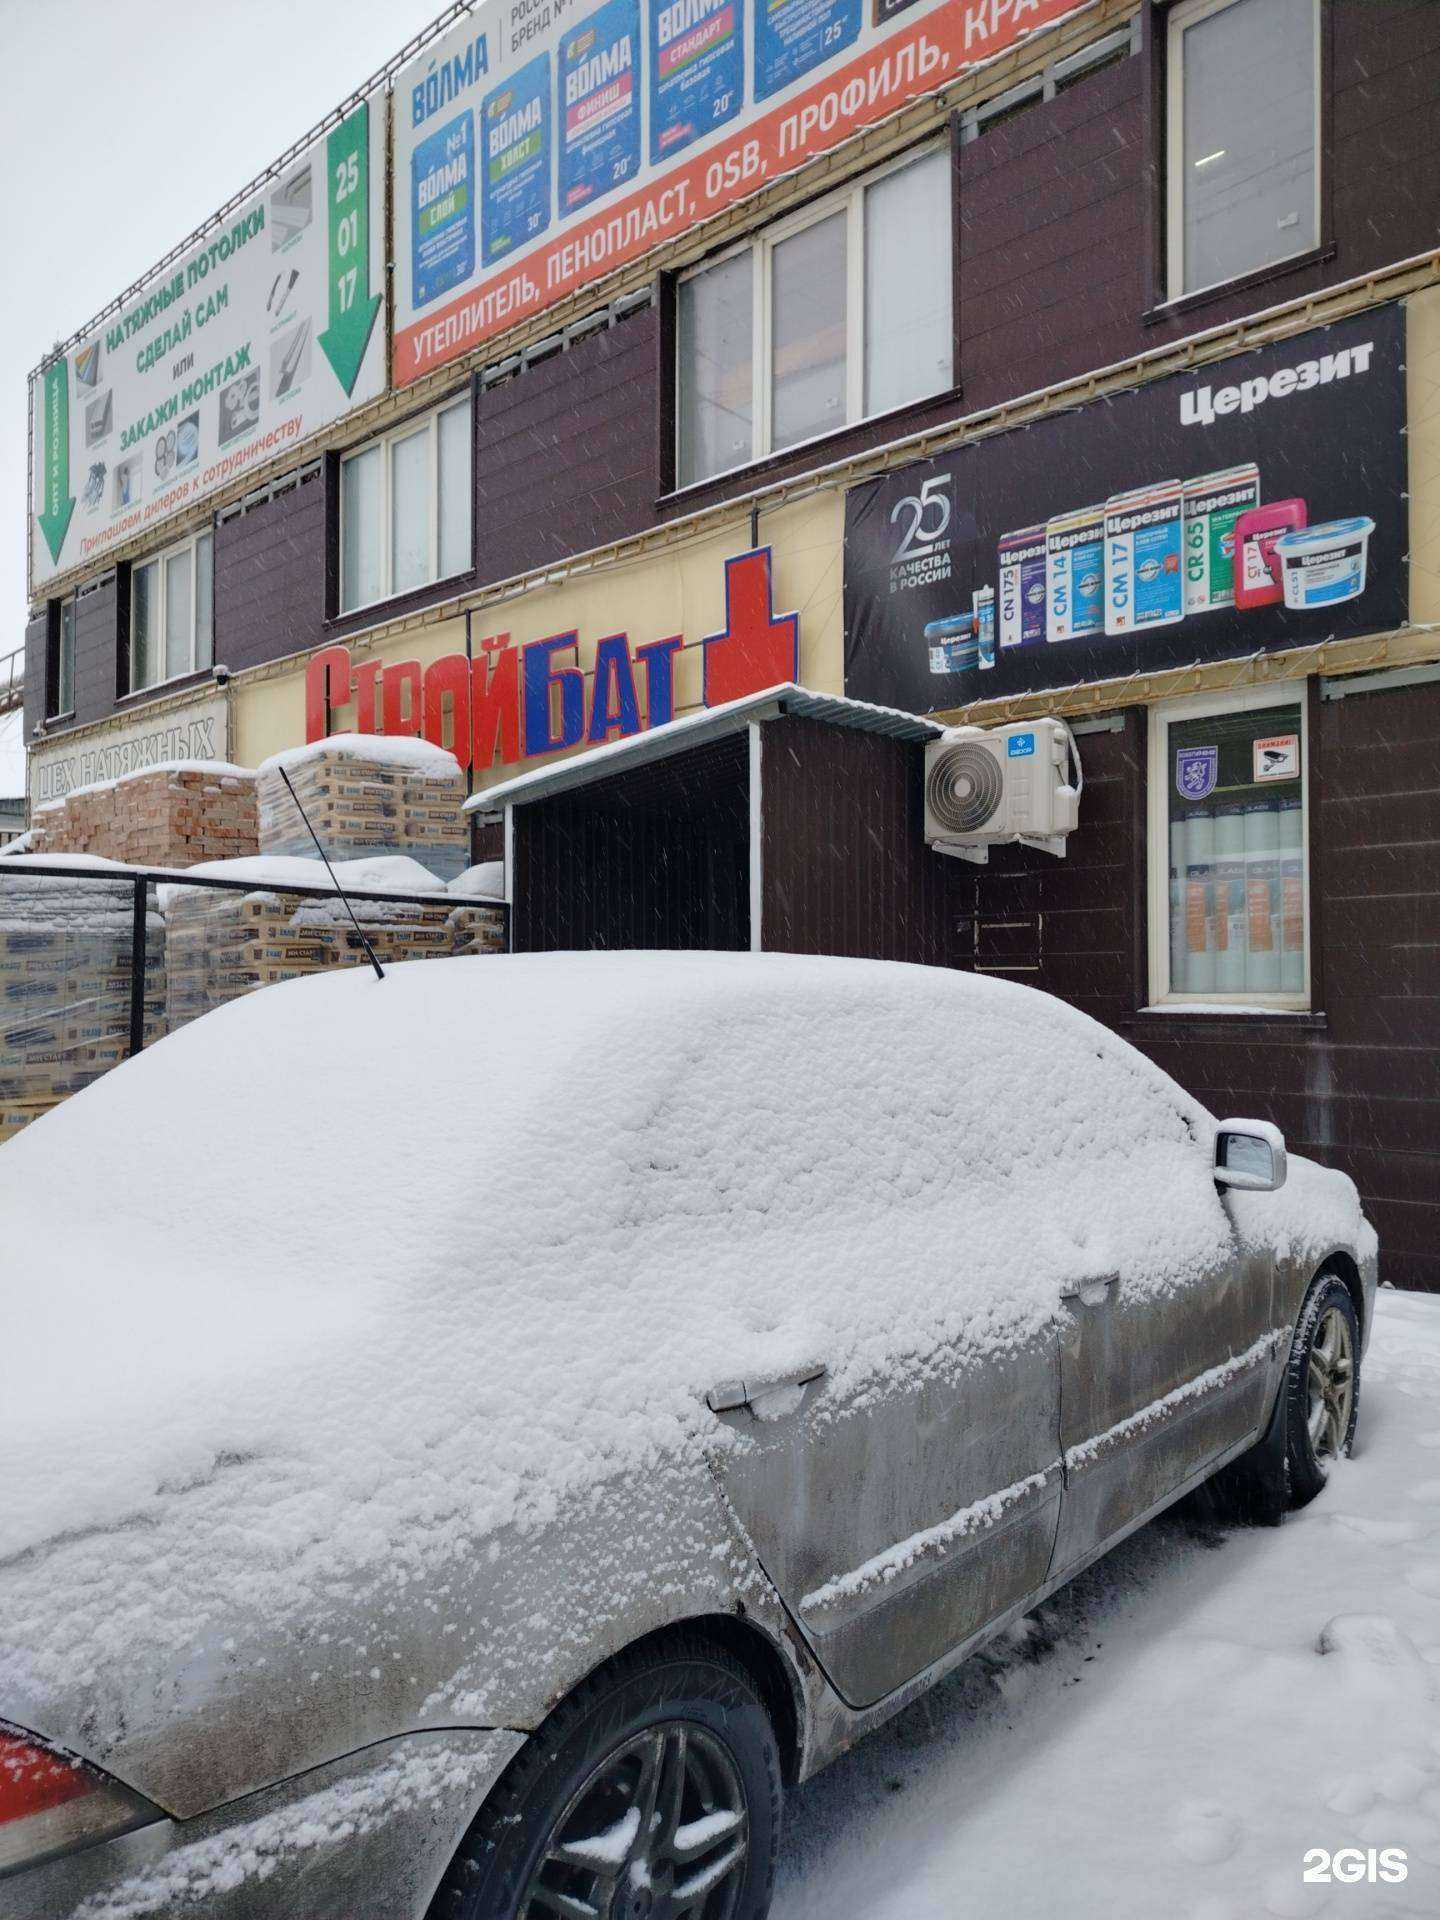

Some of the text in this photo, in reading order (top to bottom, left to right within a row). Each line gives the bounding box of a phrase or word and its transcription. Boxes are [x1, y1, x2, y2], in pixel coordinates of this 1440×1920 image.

[511, 6, 551, 52] БРЕНД
[670, 17, 722, 62] СТАНДАРТ
[577, 82, 620, 120] ФИНИШ
[336, 150, 359, 203] 25
[501, 137, 530, 171] ХОЛСТ
[414, 271, 540, 365] УТЕПЛИТЕЛЬ,
[547, 178, 697, 287] ПЕНОПЛАСТ,
[706, 139, 767, 198] OSB,
[779, 35, 950, 158] ПРОФИЛЬ,
[430, 190, 456, 226] СЛОЙ
[338, 210, 358, 257] 01
[106, 203, 266, 355] НАТЯЖНЫЕ ПОТОЛКИ
[338, 267, 358, 314] 17
[136, 308, 192, 374] СДЕЛАЙ
[195, 283, 229, 328] САМ
[172, 352, 194, 380] ИЛИ
[1180, 341, 1375, 426] Церезит
[119, 341, 252, 452] ЗАКАЖИ МОНТАЖ
[80, 512, 142, 555] Приглашаем
[144, 485, 190, 526] дилеров
[192, 475, 199, 492] к
[203, 413, 303, 485] сотрудничеству
[890, 472, 951, 564] 25
[1050, 527, 1104, 550] Церези
[1108, 504, 1180, 533] Церезит
[890, 552, 951, 580] КАЧЕСТВА
[934, 539, 951, 552] ЛЕТ
[1188, 522, 1204, 582] CR 65
[890, 566, 951, 594] В РОССИИ
[1004, 569, 1015, 621] CN 175
[1054, 555, 1067, 617] CM 14
[1113, 543, 1128, 608] CM 17
[39, 716, 216, 800] ЦЕХ НАТЯЖНЫХ
